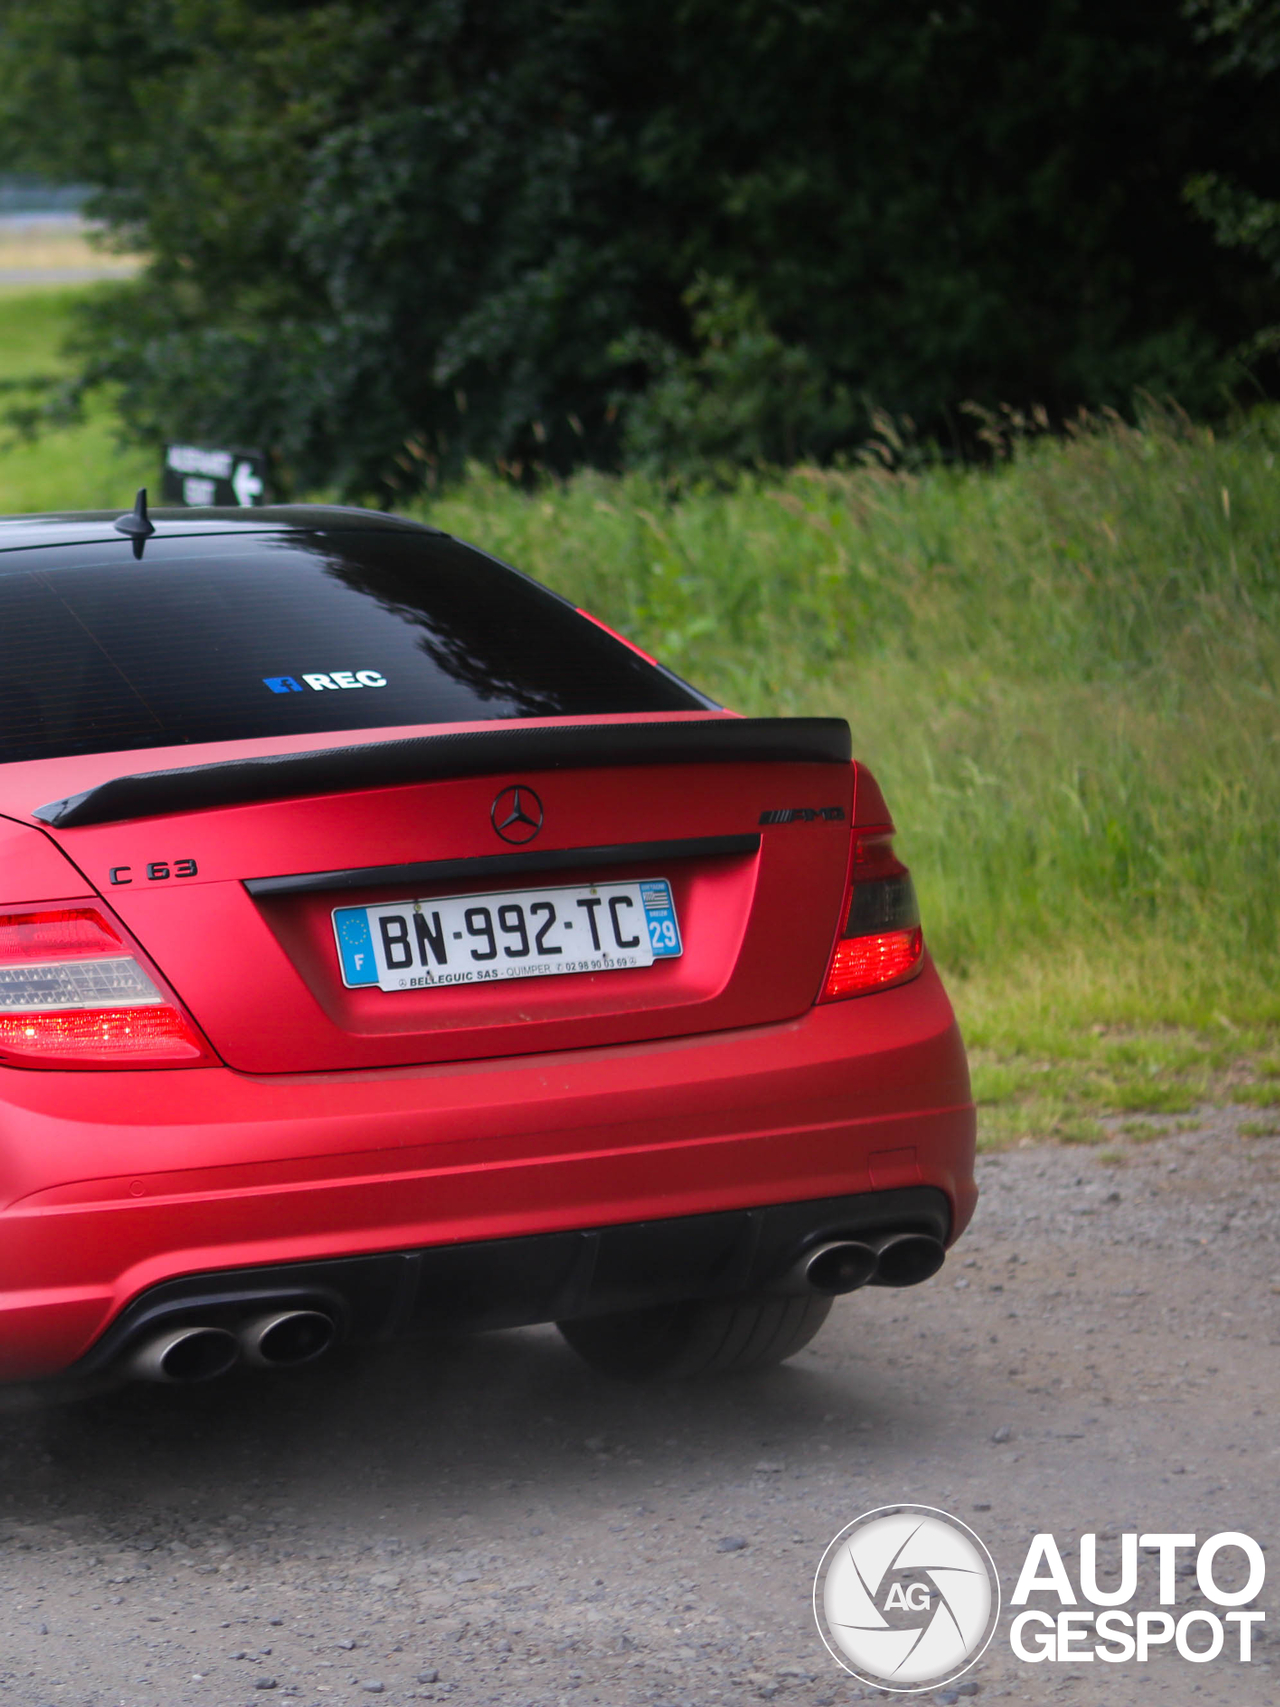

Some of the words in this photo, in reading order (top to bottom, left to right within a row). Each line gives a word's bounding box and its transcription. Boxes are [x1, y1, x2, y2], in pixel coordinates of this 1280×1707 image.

[302, 670, 387, 690] REC
[109, 866, 132, 885] C
[146, 859, 198, 881] 63
[378, 896, 640, 970] BN-992-TC
[649, 920, 676, 949] 29
[354, 953, 365, 971] F
[410, 971, 473, 987] BELLEGUIC
[477, 969, 498, 980] SAS
[506, 964, 551, 977] QUIMPER
[565, 961, 576, 972] 02
[578, 960, 589, 970] 98
[591, 960, 602, 969] 90
[604, 959, 615, 968] 03
